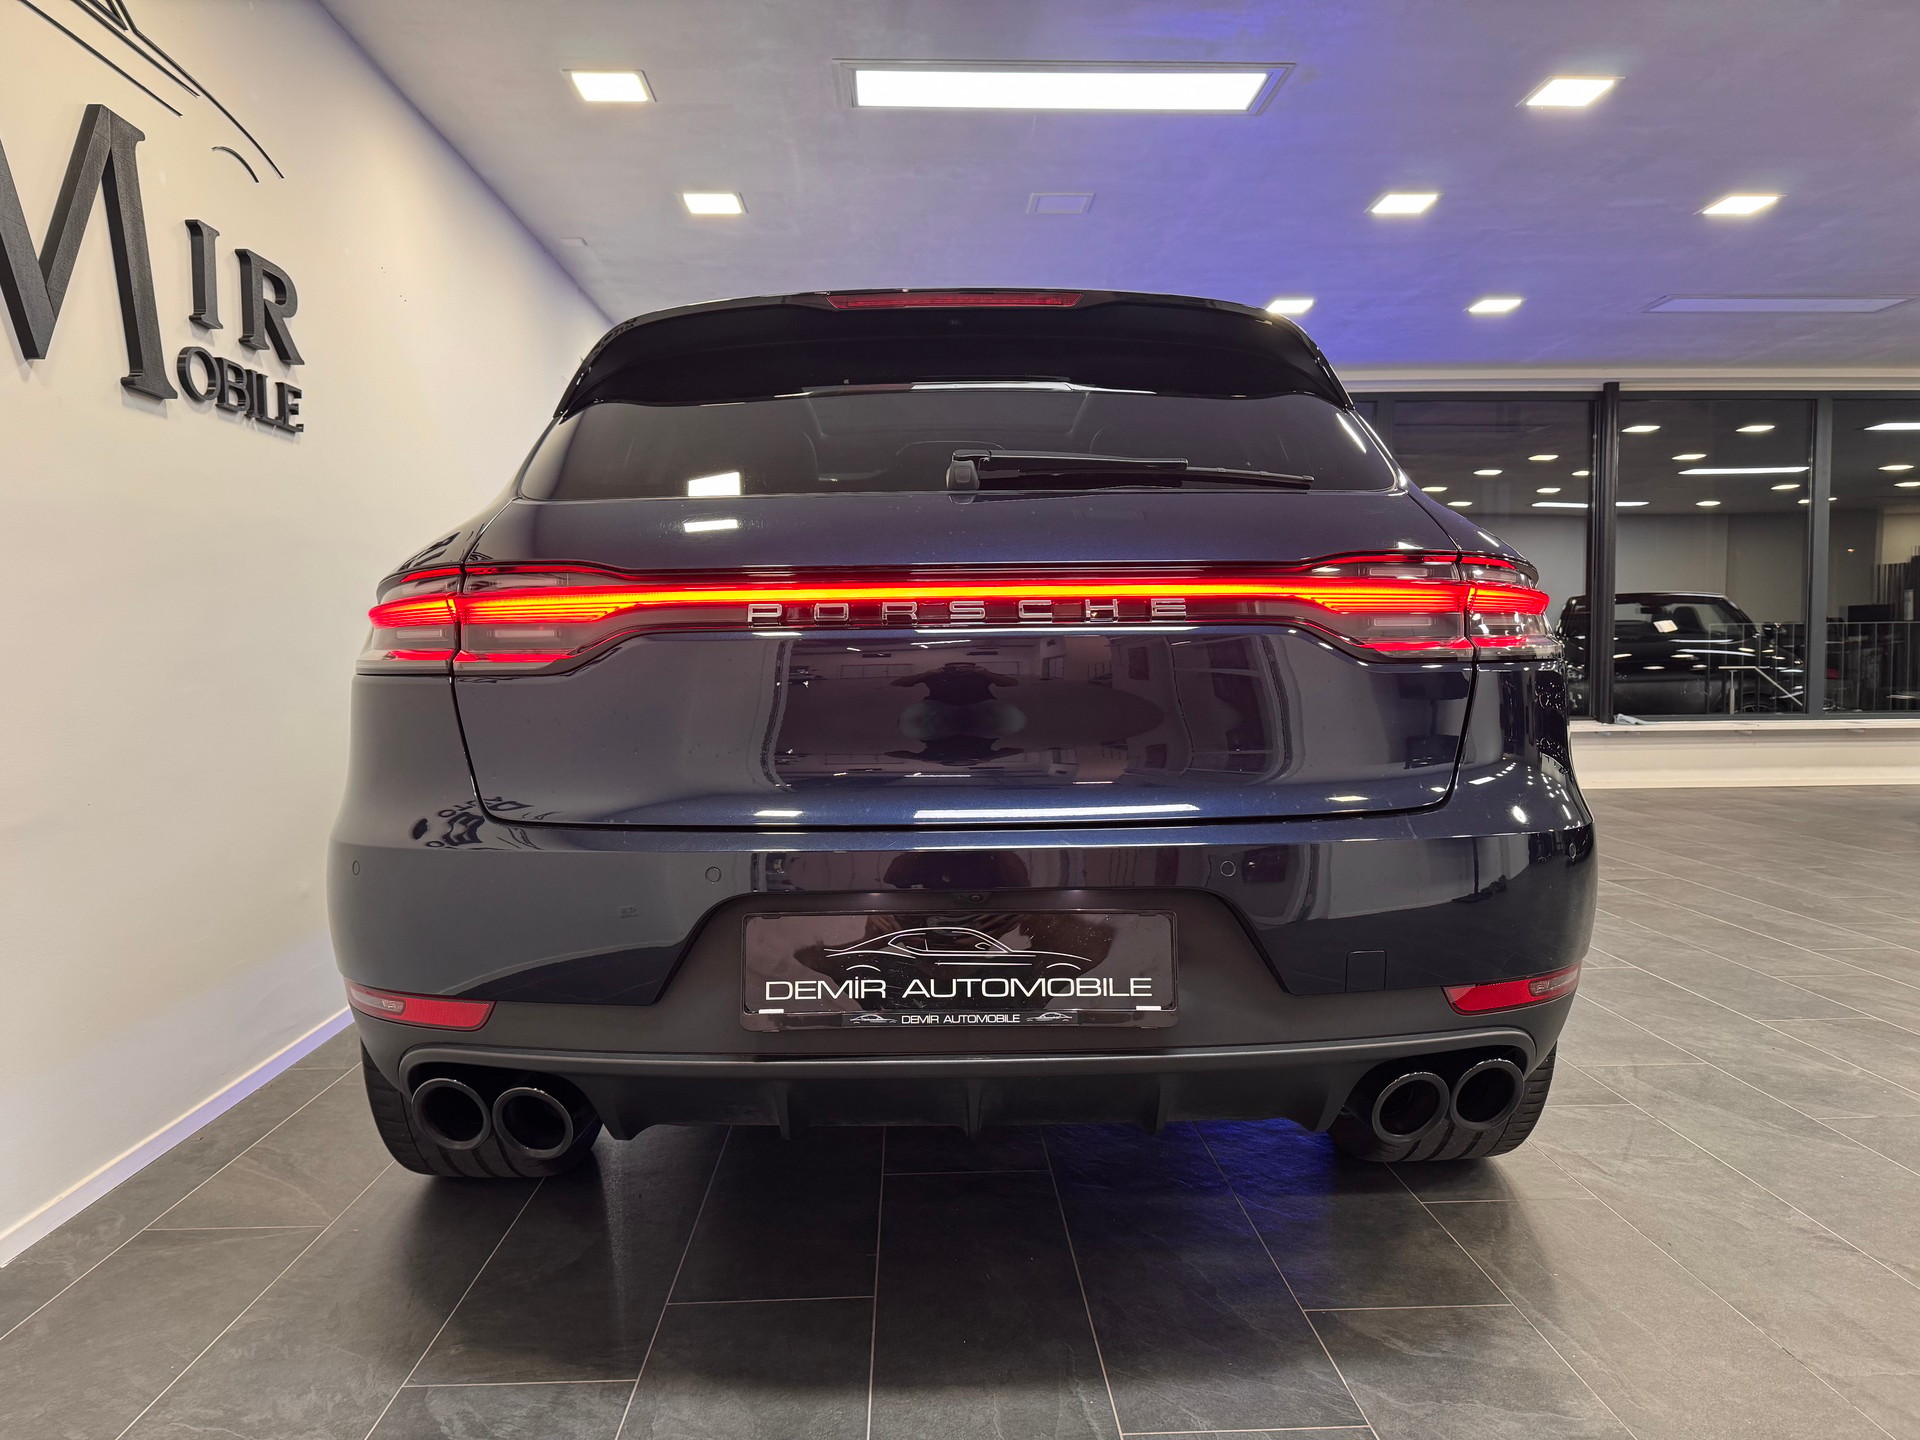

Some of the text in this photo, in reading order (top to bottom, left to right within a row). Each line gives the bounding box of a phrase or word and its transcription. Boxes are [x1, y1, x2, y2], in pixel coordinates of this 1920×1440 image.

[747, 598, 1187, 626] PORSCHE
[902, 978, 1152, 998] AUTOMOBILE
[943, 1013, 1020, 1024] AUTOMOBILE
